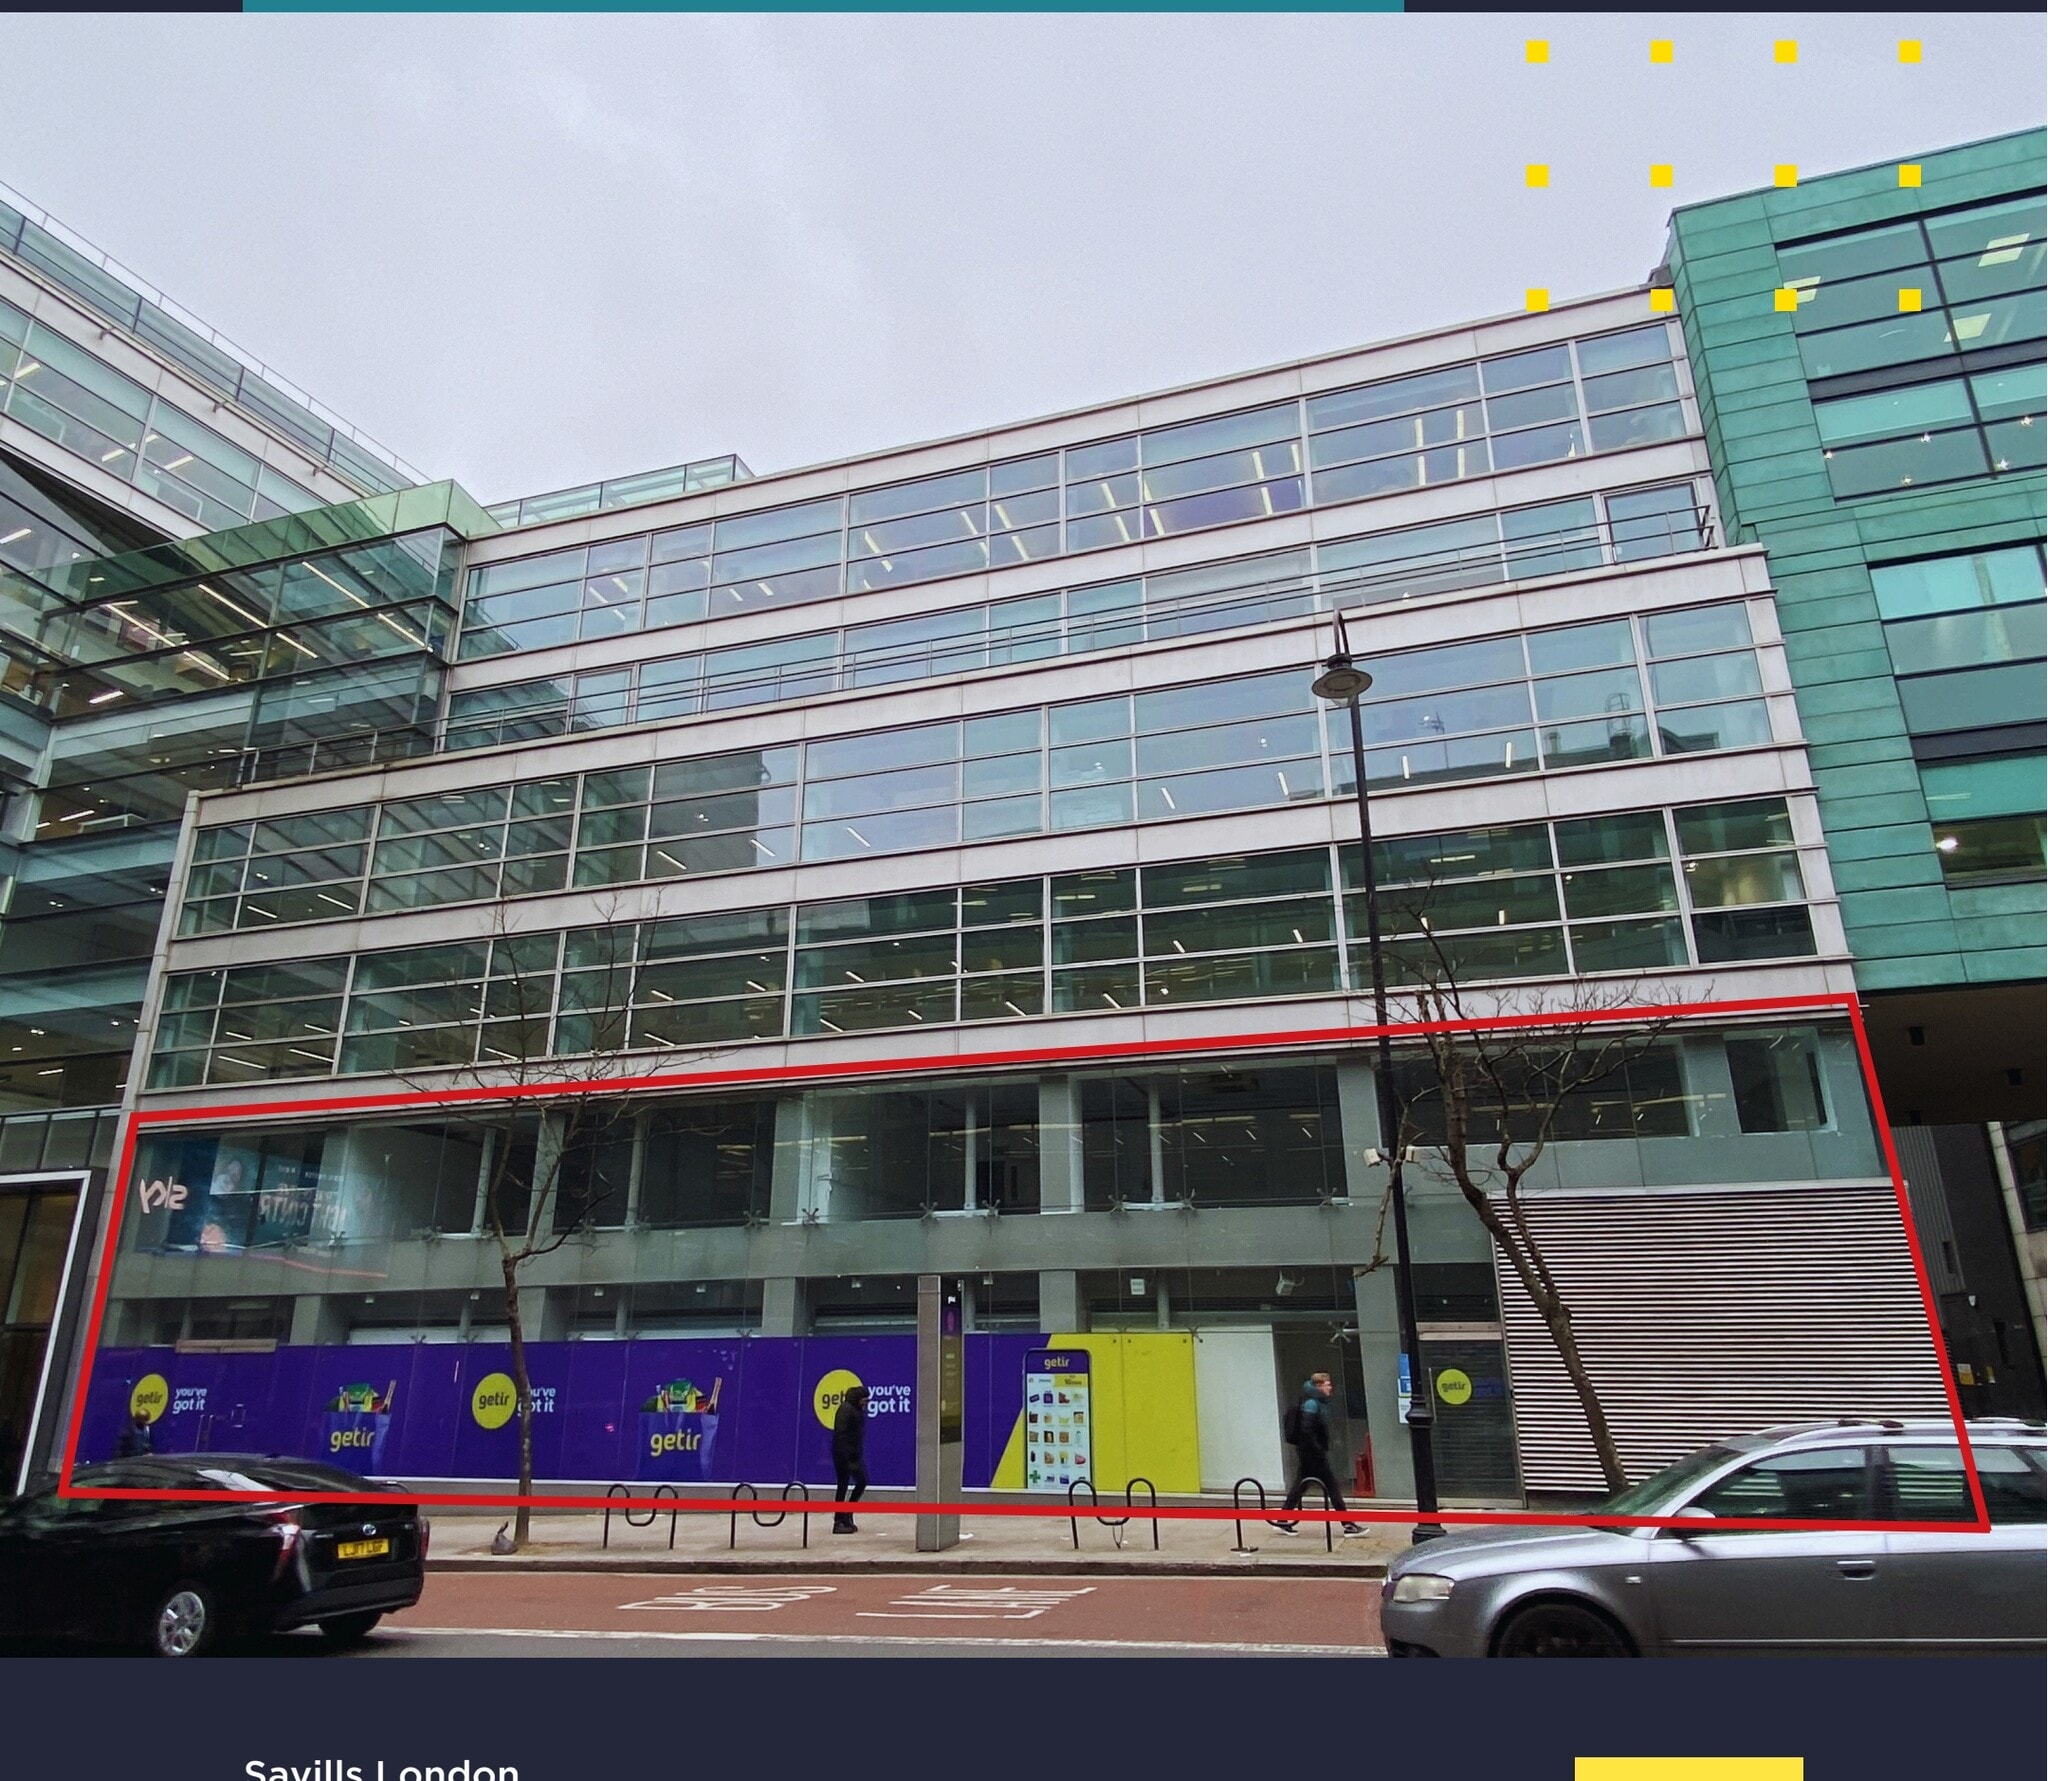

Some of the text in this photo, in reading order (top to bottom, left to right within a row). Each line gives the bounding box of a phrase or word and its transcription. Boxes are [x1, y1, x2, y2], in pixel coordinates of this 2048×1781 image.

[1044, 1355, 1070, 1370] getir
[175, 1387, 208, 1400] you've
[867, 1384, 911, 1399] you've
[1441, 1381, 1466, 1392] getir
[136, 1390, 163, 1407] getir
[172, 1395, 206, 1415] got it
[478, 1391, 511, 1410] getir
[543, 1396, 555, 1412] it
[821, 1390, 847, 1410] get
[867, 1395, 911, 1418] got it
[329, 1426, 376, 1453] getir
[650, 1427, 702, 1458] getir
[615, 1585, 838, 1611] BUS
[856, 1584, 1098, 1620] LANE
